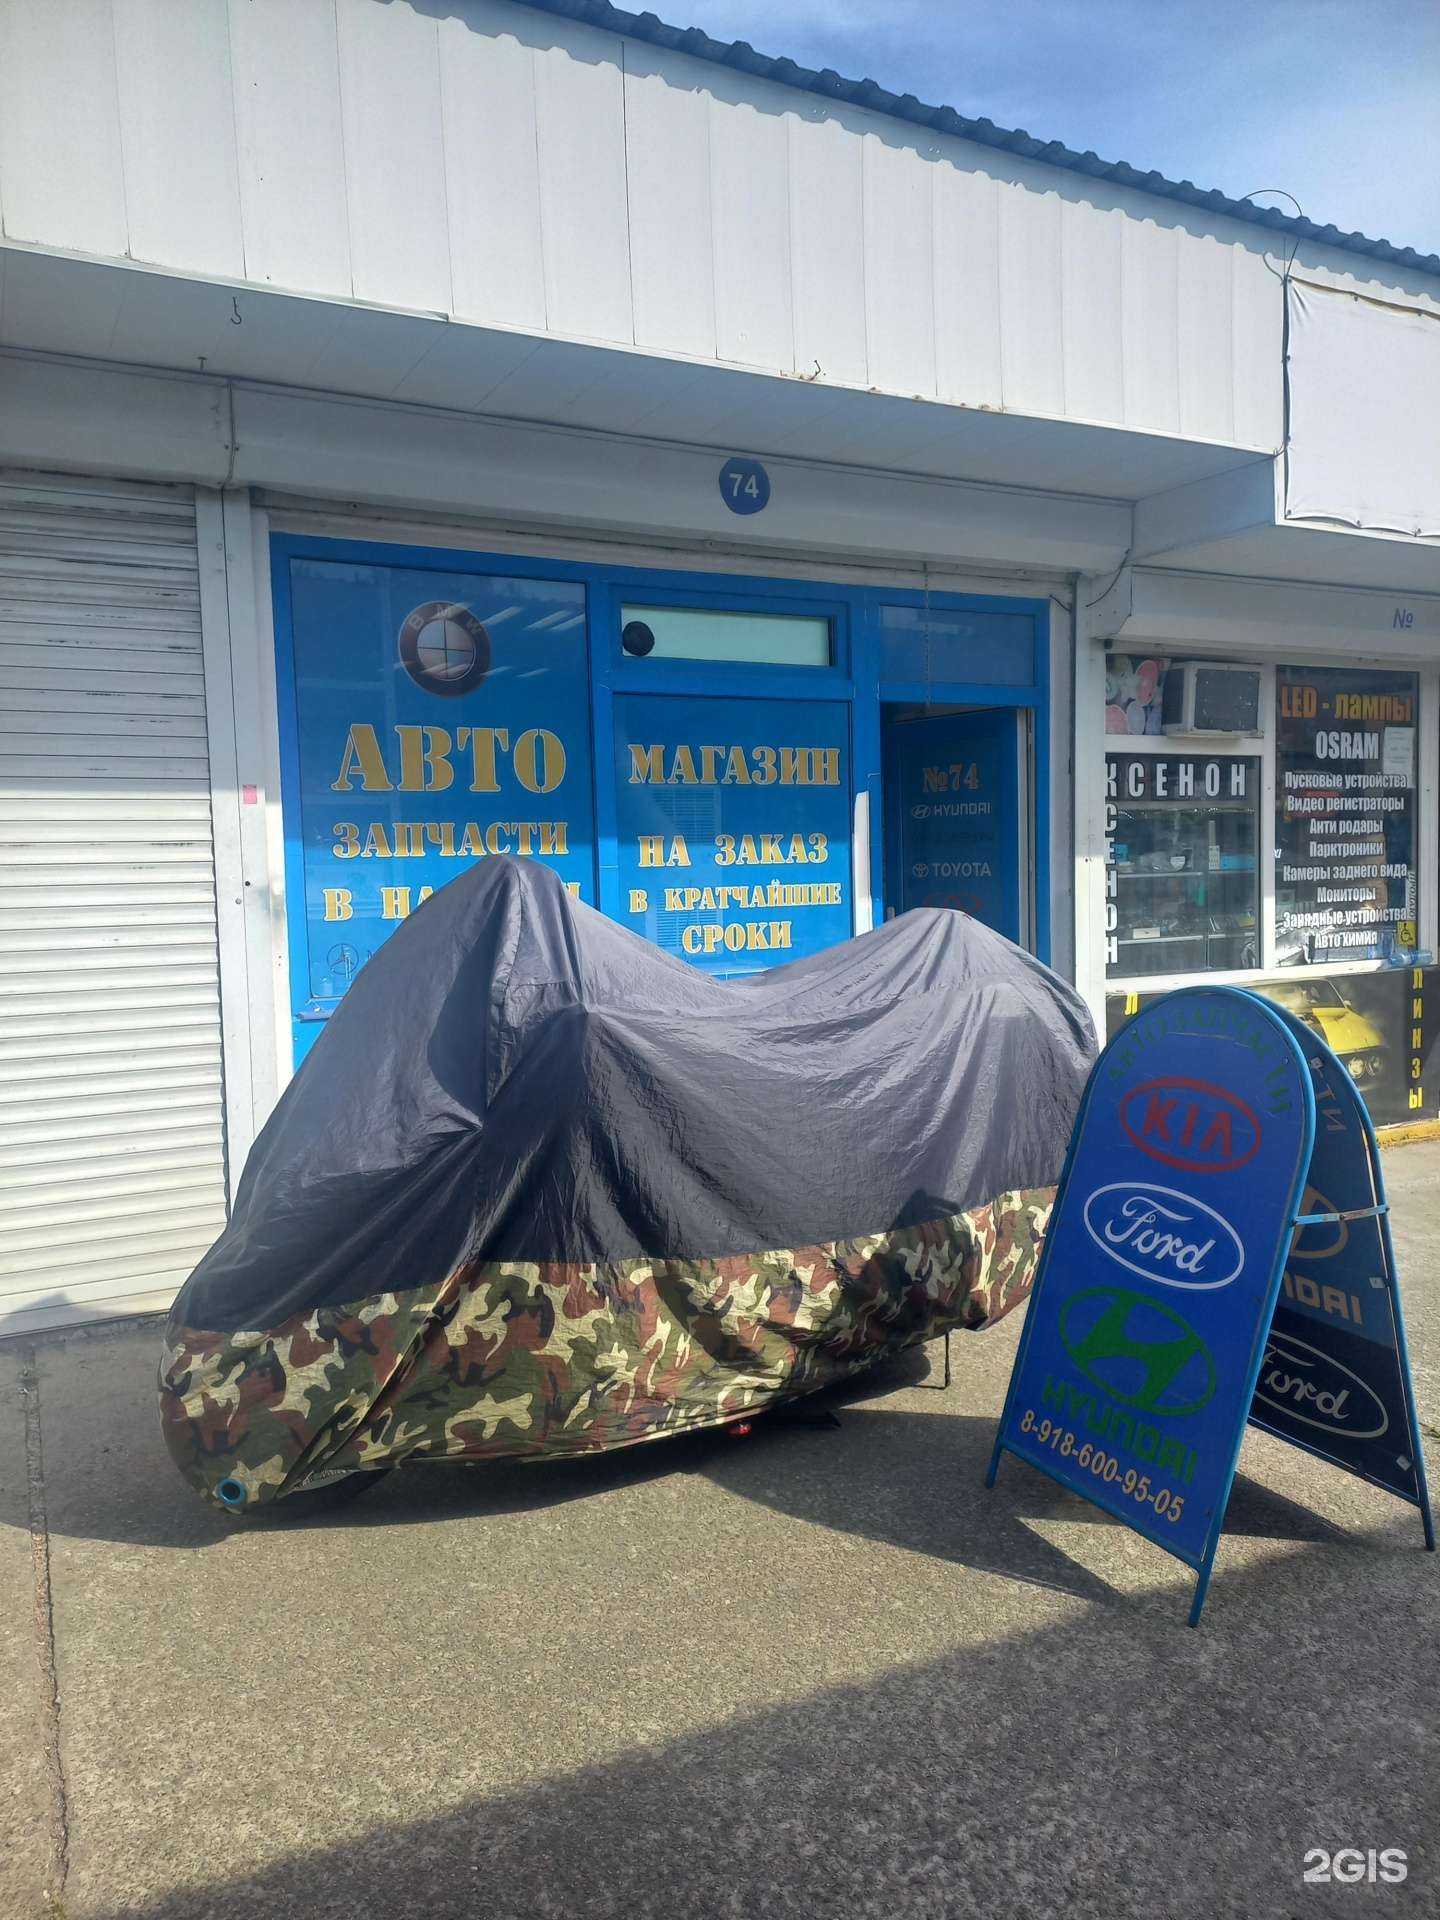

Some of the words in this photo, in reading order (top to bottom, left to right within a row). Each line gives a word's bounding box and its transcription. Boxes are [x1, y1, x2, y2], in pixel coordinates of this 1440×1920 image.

[729, 473, 760, 498] 74
[1281, 686, 1318, 718] LED
[331, 723, 567, 794] АВТО
[1315, 730, 1379, 759] OSRAM
[628, 744, 841, 786] МАГАЗИН
[923, 762, 980, 793] №74
[1105, 762, 1246, 797] КСЕНОН
[1285, 772, 1343, 789] Пусковые
[1345, 772, 1407, 790] устройства
[934, 802, 992, 817] HYUNDAI
[1287, 795, 1325, 813] Видео
[1326, 796, 1404, 812] регистраторы
[332, 822, 569, 858] ЗАПЧАСТИ
[1310, 818, 1337, 834] Анти
[638, 835, 691, 867] НА
[714, 833, 828, 866] ЗАКАЗ
[1309, 841, 1384, 858] Парктроники
[932, 862, 993, 878] TOYOTA
[1283, 864, 1331, 882] Камеры
[1333, 864, 1378, 880] заднего
[1380, 863, 1407, 878] вида
[323, 888, 353, 921] В
[629, 889, 648, 913] В
[664, 879, 842, 911] КРАТЧАЙШИЕ
[1317, 887, 1376, 903] Мониторы
[1283, 910, 1342, 929] Зарядные
[1345, 907, 1407, 926] устройства
[682, 921, 792, 954] СРОКИ
[1314, 932, 1340, 949] Авто
[1342, 931, 1378, 947] химия
[1143, 1091, 1233, 1159] KIA
[1104, 1196, 1217, 1274] Ford
[1042, 1375, 1198, 1486] HYUNDAI
[1020, 1409, 1185, 1522] 8-918-600-95-05
